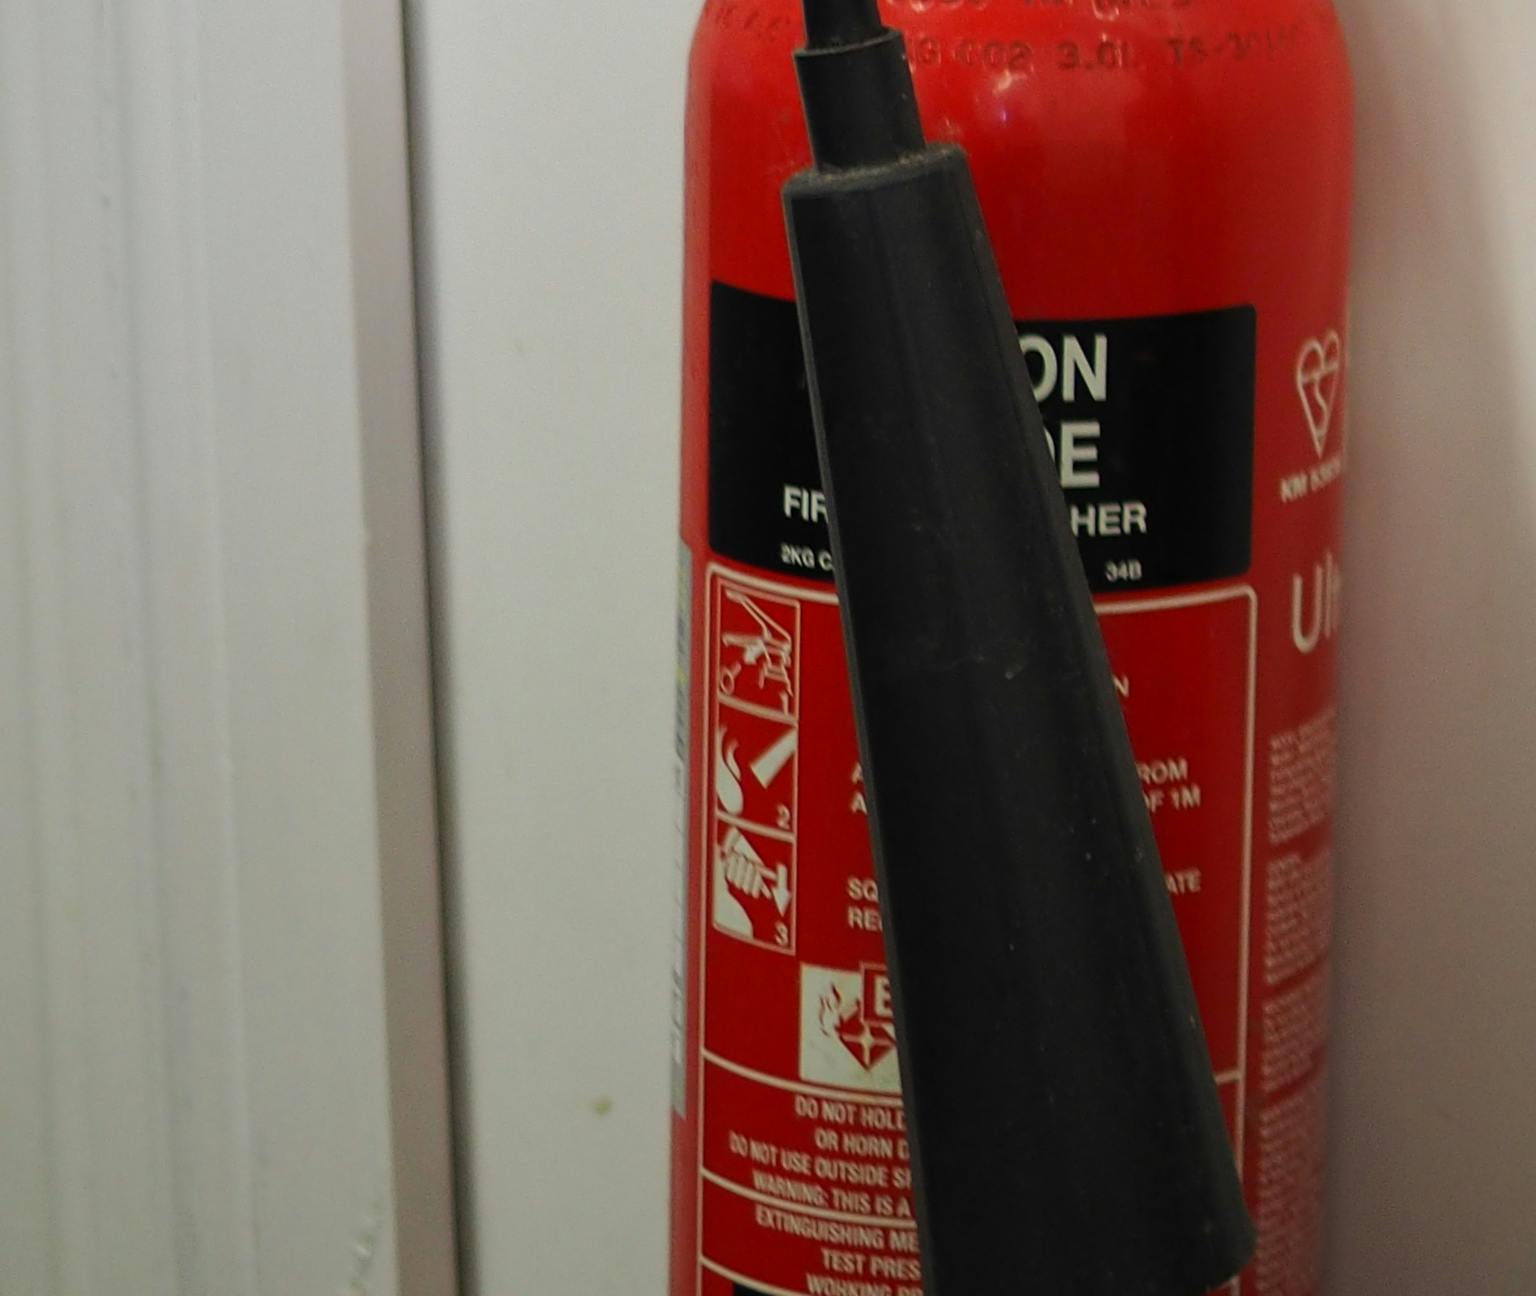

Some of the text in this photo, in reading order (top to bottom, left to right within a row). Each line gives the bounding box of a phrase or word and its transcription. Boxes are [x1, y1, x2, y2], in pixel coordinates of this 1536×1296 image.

[776, 804, 791, 830] 2
[774, 922, 789, 945] 3
[795, 1094, 819, 1120] DO
[822, 1101, 857, 1126] NOT
[815, 1127, 840, 1153] OR
[843, 1133, 894, 1159] HORN
[729, 1130, 749, 1158] DO
[751, 1139, 778, 1168] NOT
[781, 1149, 813, 1177] USE
[815, 1157, 889, 1189] OUTSIDE
[832, 1188, 871, 1215] THIS
[876, 1194, 894, 1217] IS
[756, 1203, 885, 1251] EXTINGUISHING
[821, 1247, 867, 1275] TEST
